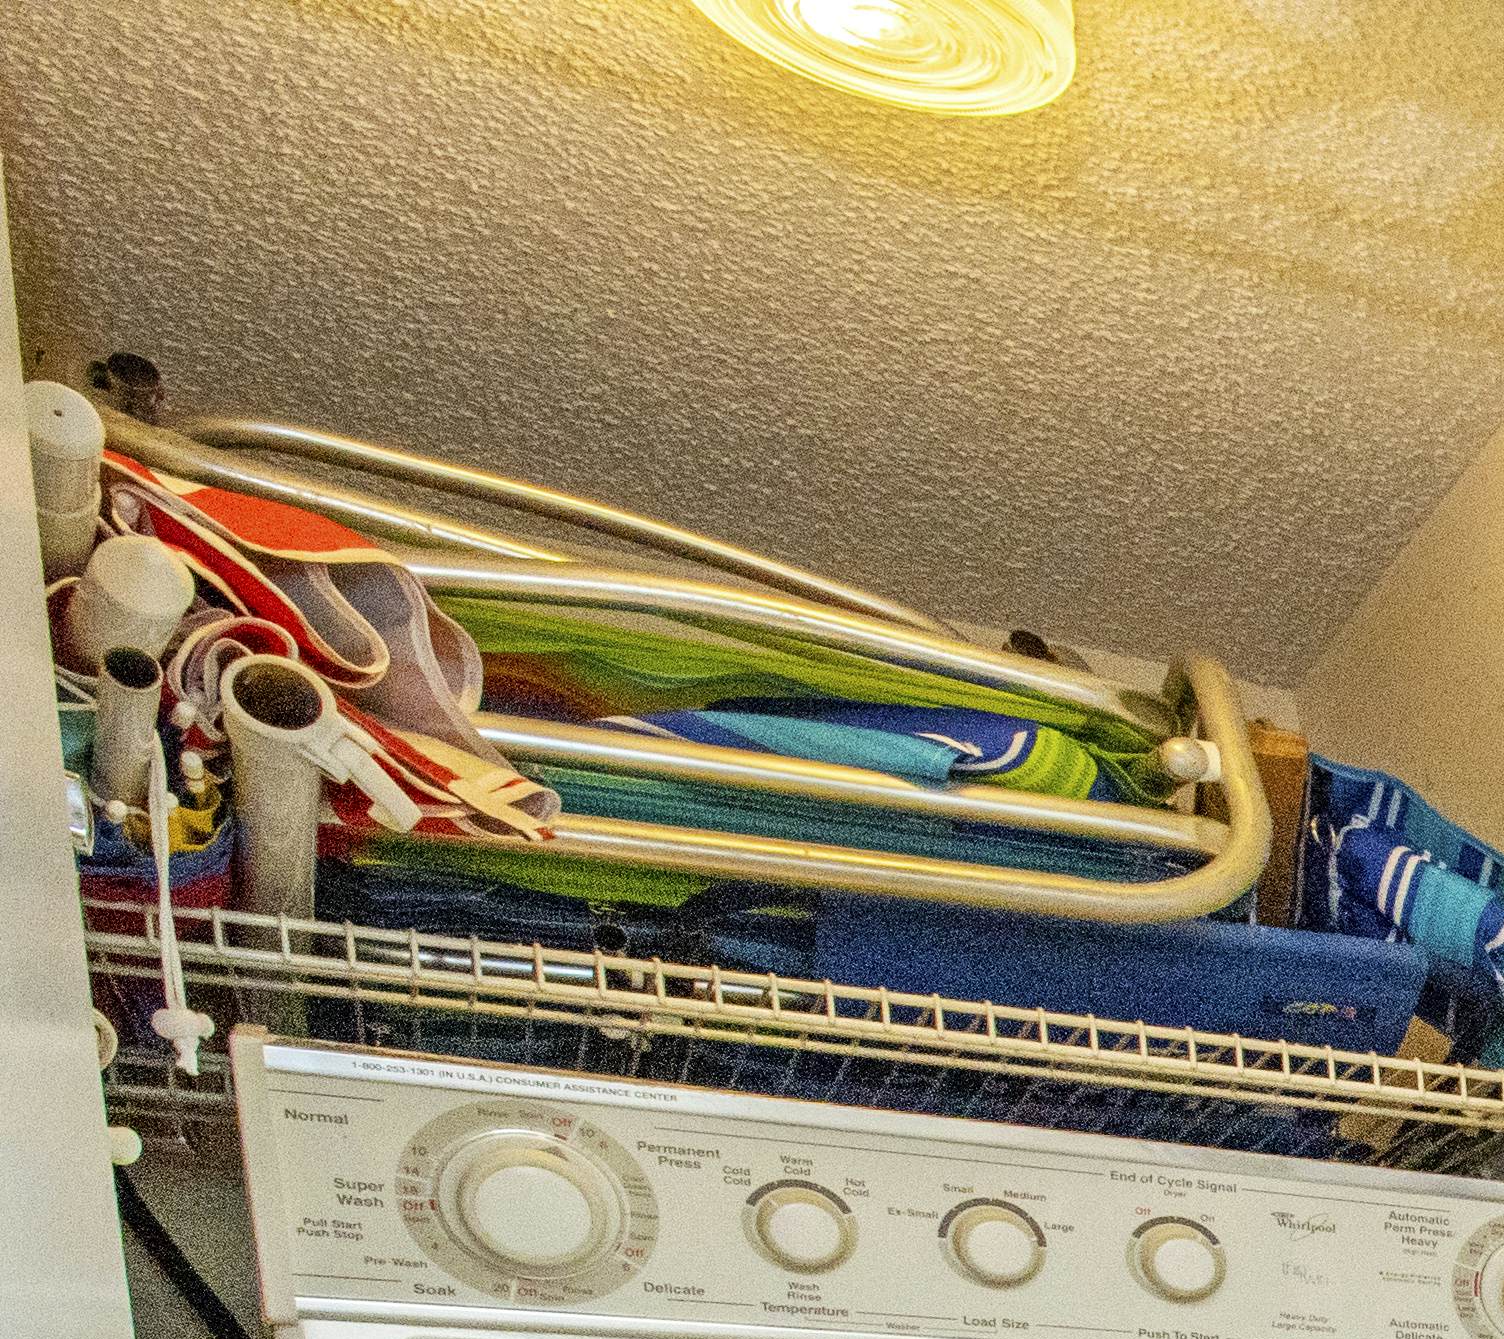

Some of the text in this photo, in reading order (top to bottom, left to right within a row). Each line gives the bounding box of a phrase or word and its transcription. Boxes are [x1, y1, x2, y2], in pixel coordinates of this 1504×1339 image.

[351, 1061, 678, 1102] 1-800-253-1301 (IN U.S.A.) CONSUMER ASSISTANCE CENTER
[283, 1107, 349, 1125] Normal
[552, 1116, 572, 1128] Off
[637, 1140, 721, 1159] Permanent
[658, 1156, 702, 1170] Press
[779, 1155, 813, 1167] Warm
[722, 1165, 751, 1177] Cold
[783, 1166, 811, 1177] Cold
[333, 1177, 385, 1193] Super
[723, 1176, 751, 1187] Cold
[845, 1177, 866, 1188] Hot
[1110, 1171, 1237, 1193] End of Cycle Signal
[843, 1187, 869, 1198] Cold
[943, 1183, 974, 1194] Small
[1163, 1189, 1186, 1198] Dryer
[336, 1193, 385, 1208] Wash
[1003, 1189, 1047, 1202] Medium
[403, 1200, 423, 1211] Off
[1135, 1206, 1151, 1216] Off
[887, 1207, 939, 1220] Ex-Small
[1200, 1214, 1215, 1223] On
[1388, 1210, 1450, 1226] Automatic
[303, 1217, 362, 1231] Pull Start
[1044, 1221, 1075, 1233] Large
[1276, 1217, 1336, 1235] Whirlpool
[1384, 1222, 1453, 1238] Perm Press
[297, 1227, 364, 1241] Push Stop
[1401, 1236, 1438, 1250] Heavy
[624, 1247, 645, 1258] Off
[413, 1283, 456, 1297] Soak
[643, 1282, 705, 1297] Delicate
[788, 1281, 820, 1292] Wash
[787, 1291, 822, 1302] Rinse
[761, 1302, 849, 1318] Temperature
[963, 1316, 1030, 1330] Load Size
[1272, 1321, 1296, 1331] Large
[1389, 1318, 1450, 1332] Automatic
[1138, 1328, 1170, 1339] Push
